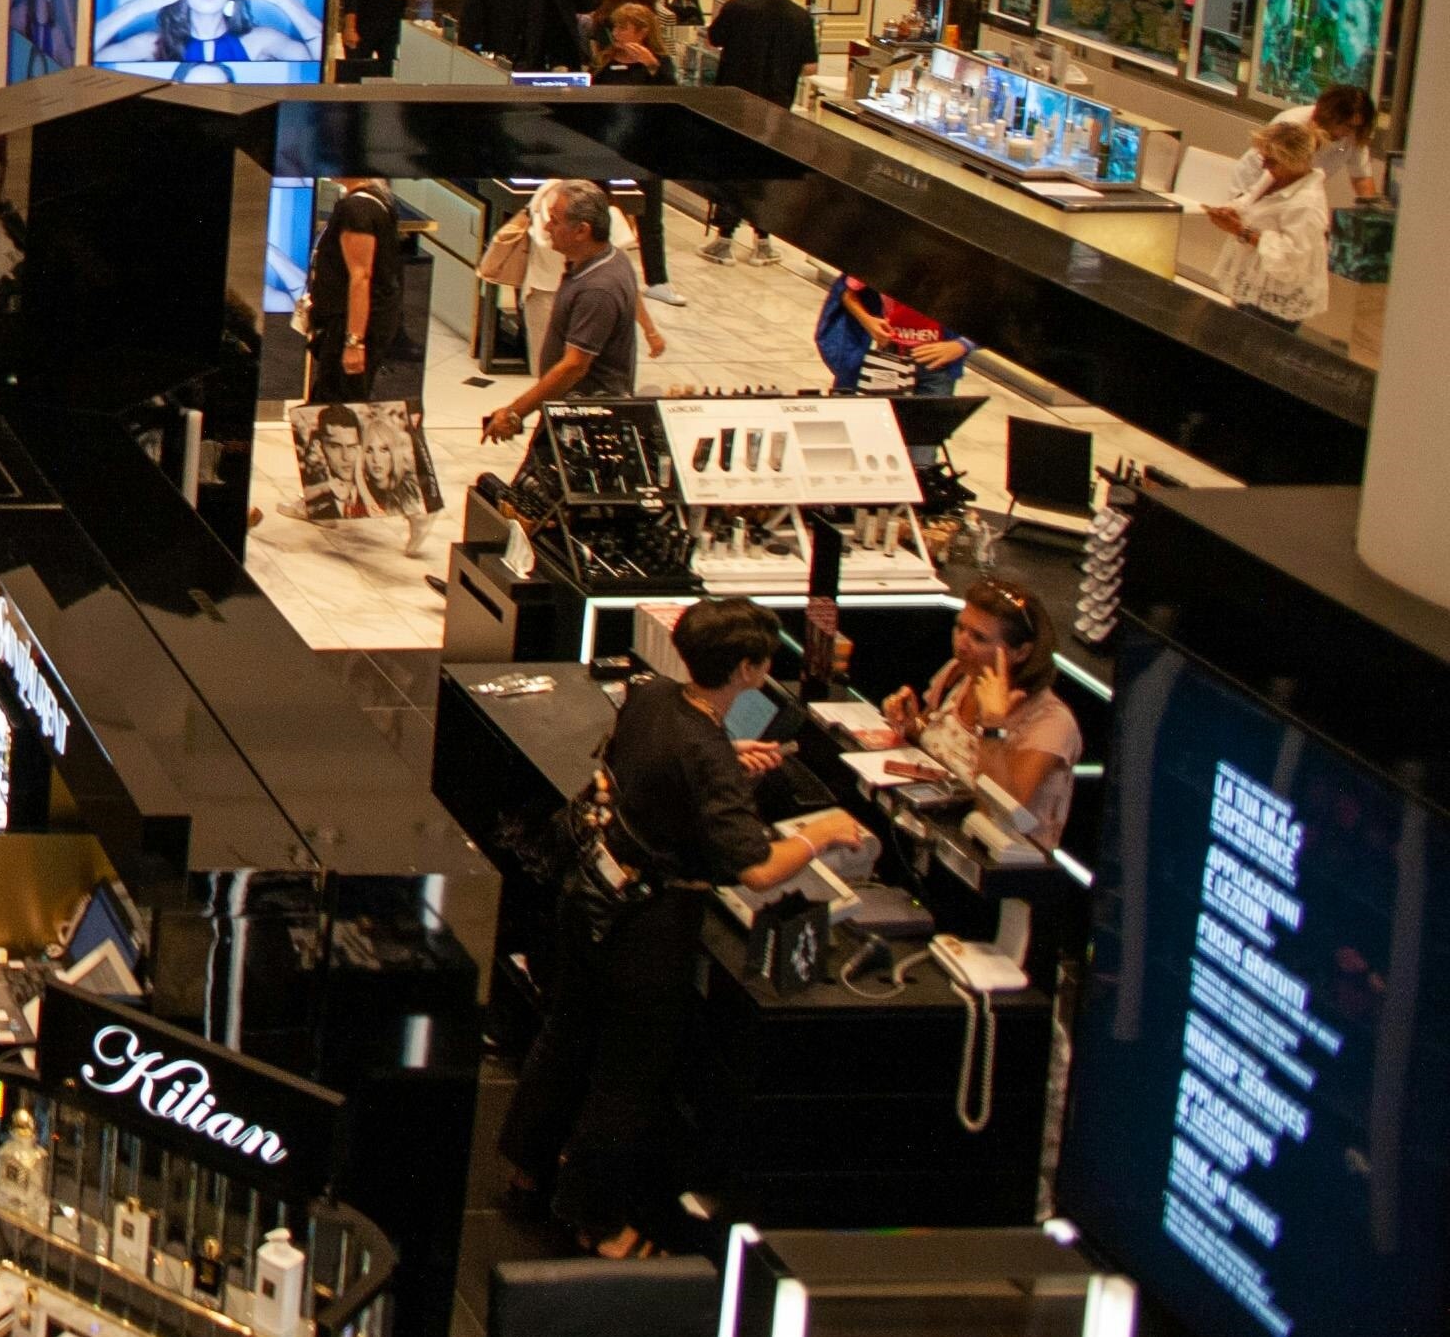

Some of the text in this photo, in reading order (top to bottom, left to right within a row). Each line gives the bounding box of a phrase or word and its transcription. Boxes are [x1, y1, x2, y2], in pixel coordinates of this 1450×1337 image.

[1211, 797, 1295, 870] EXPERIENCE
[1197, 913, 1243, 963] FOCUS
[80, 1024, 288, 1163] Kilian
